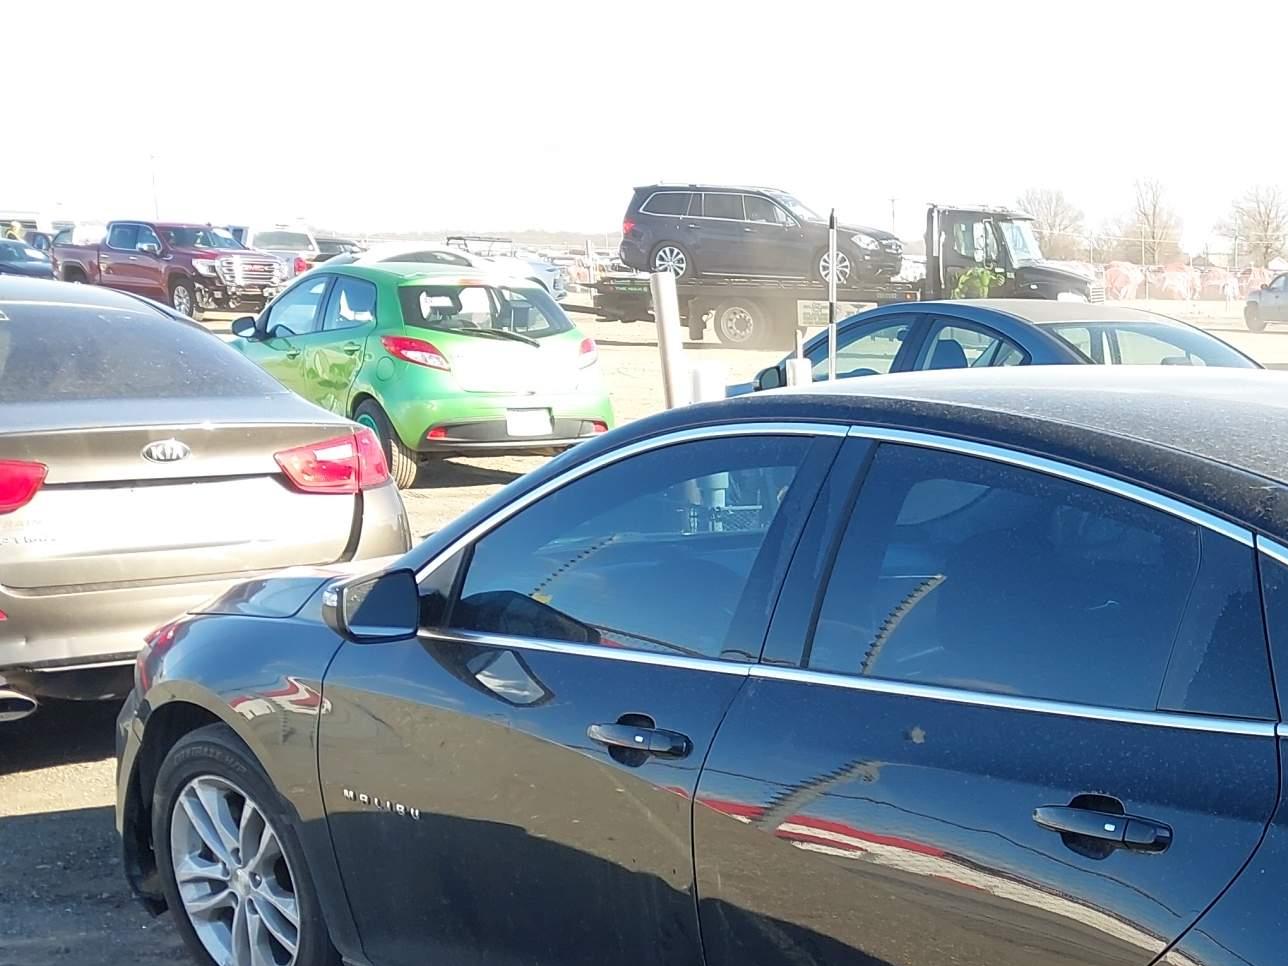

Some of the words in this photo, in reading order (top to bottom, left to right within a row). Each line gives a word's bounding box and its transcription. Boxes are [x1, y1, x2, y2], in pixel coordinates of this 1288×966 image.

[242, 264, 274, 272] GMC
[150, 446, 184, 460] KIA
[343, 788, 421, 820] MALIBU
